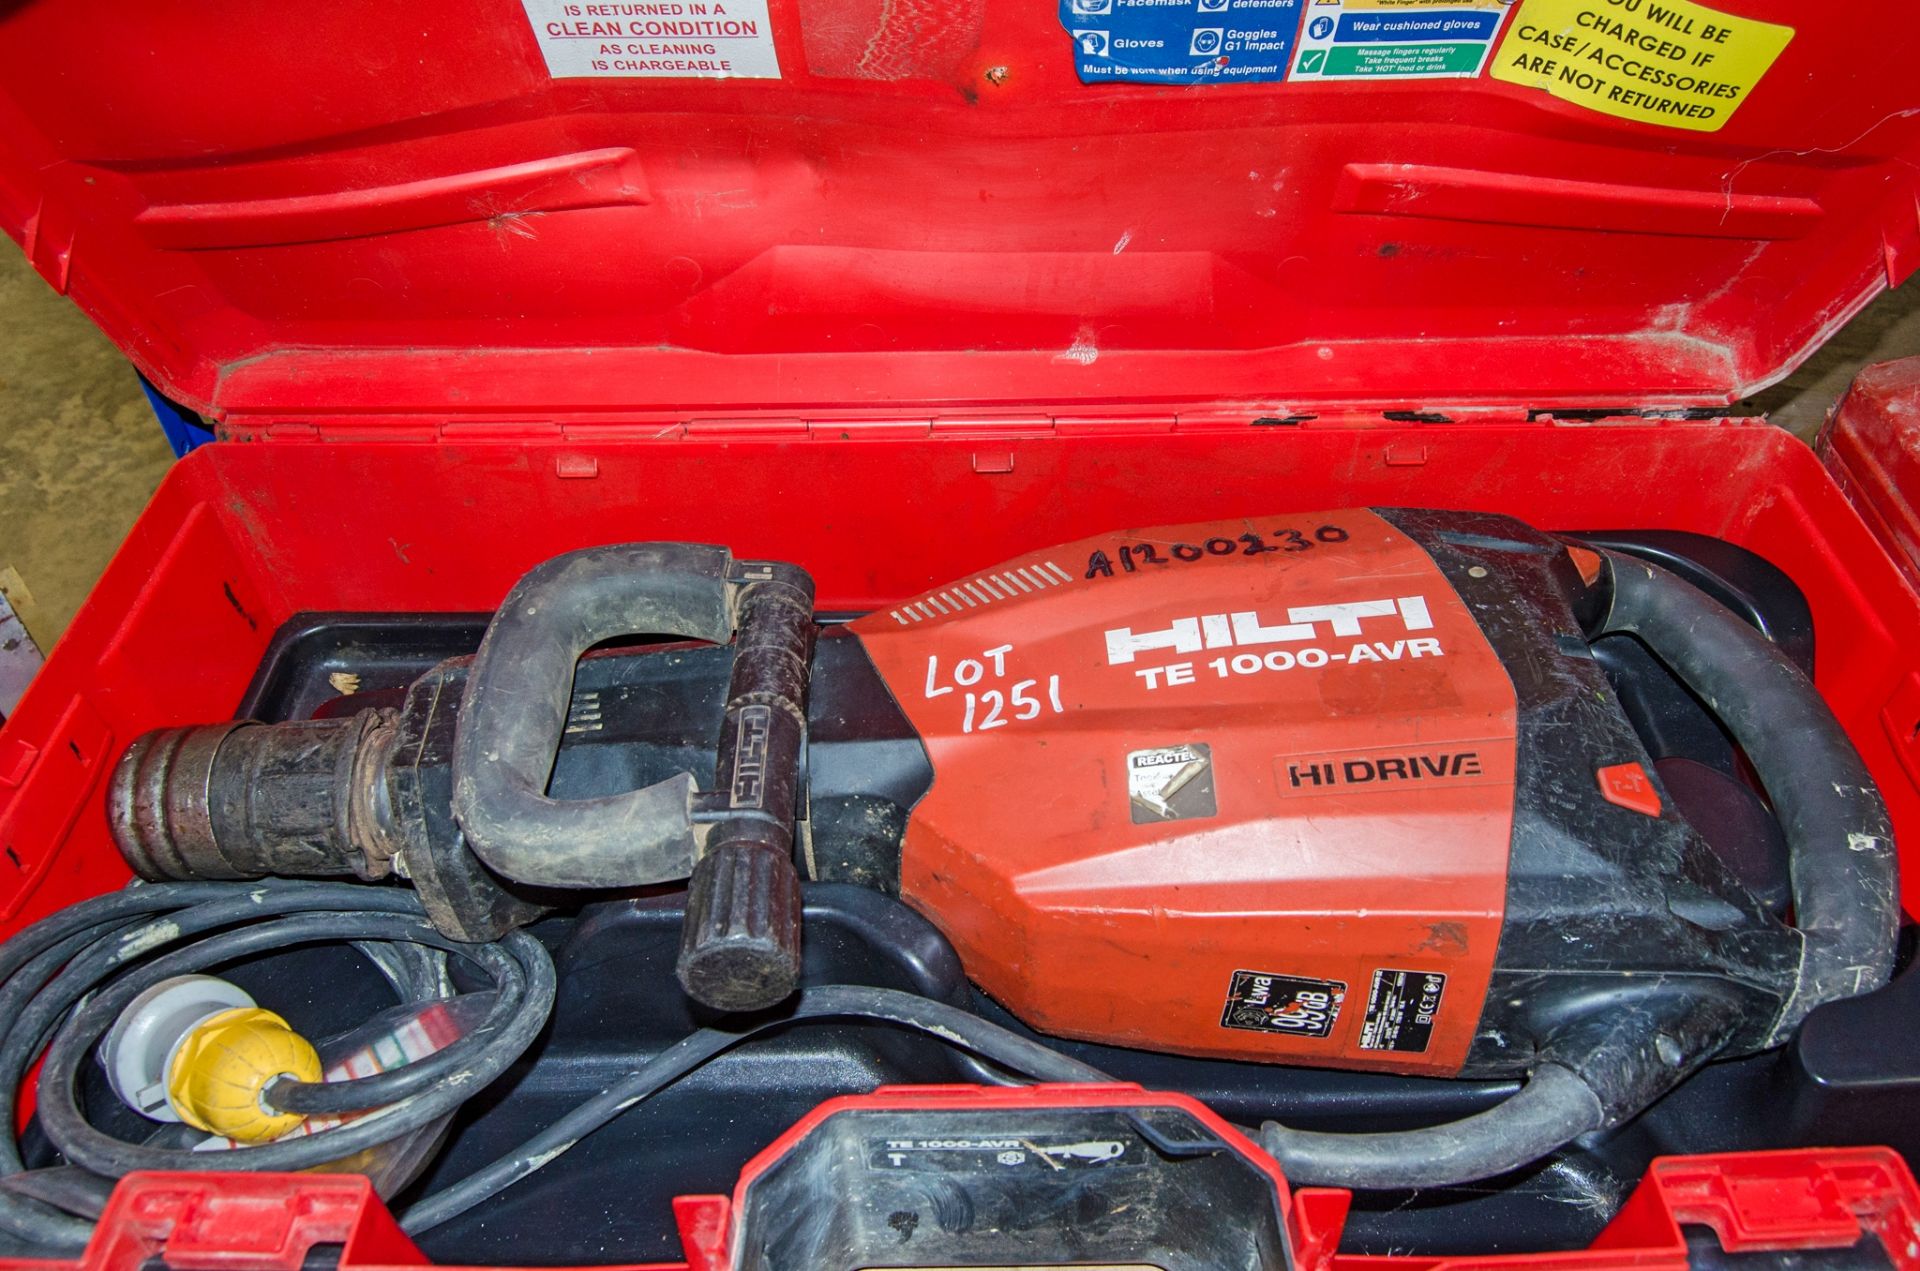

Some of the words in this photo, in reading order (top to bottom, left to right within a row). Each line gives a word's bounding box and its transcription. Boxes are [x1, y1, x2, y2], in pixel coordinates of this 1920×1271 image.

[564, 4, 581, 16] IS
[587, 3, 683, 16] RETURNED
[690, 3, 706, 15] IN
[713, 4, 726, 15] A
[1233, 0, 1294, 8] defenders
[546, 21, 622, 36] CLEAN
[629, 20, 757, 36] CONDITION
[1353, 21, 1381, 31] Wear
[1383, 20, 1442, 31] cushioned
[1443, 19, 1480, 31] gloves
[1646, 3, 1694, 35] WILL
[1700, 25, 1732, 44] BE
[1227, 29, 1277, 40] Goggles
[1576, 11, 1686, 61] CHARGED
[1690, 51, 1715, 68] IF
[600, 44, 622, 55] AS
[627, 43, 716, 55] CLEANING
[1114, 39, 1164, 48] Gloves
[1224, 41, 1241, 51] G1
[1245, 41, 1285, 52] Impact
[1357, 48, 1391, 57] Massage
[1393, 47, 1419, 56] fingers
[1421, 46, 1456, 55] regularly
[592, 60, 608, 70] IS
[614, 59, 732, 71] CHARGEABLE
[1364, 57, 1382, 65] Take
[1384, 56, 1417, 65] frequent
[1418, 55, 1443, 63] breaks
[1518, 25, 1741, 99] CASE/ACCESSORIES
[1084, 64, 1112, 74] Must
[1115, 65, 1128, 74] be
[1158, 67, 1187, 75] when
[1191, 67, 1220, 76] using
[1224, 65, 1277, 76] equipment
[1355, 65, 1373, 73] Take
[1397, 64, 1415, 72] food
[1426, 63, 1446, 71] drink
[1511, 53, 1557, 76] ARE
[1558, 65, 1606, 94] NOT
[1608, 85, 1716, 119] RETURNED
[1104, 595, 1434, 666] HILTI
[1135, 661, 1196, 690] TE
[1208, 637, 1445, 679] 1000-AVR
[925, 644, 1013, 698] LOT
[963, 674, 1064, 733] 1251
[1289, 763, 1335, 787] HI
[1343, 752, 1481, 783] DRIVE
[886, 1140, 913, 1148] TE
[918, 1139, 1020, 1148] 1000-AVR
